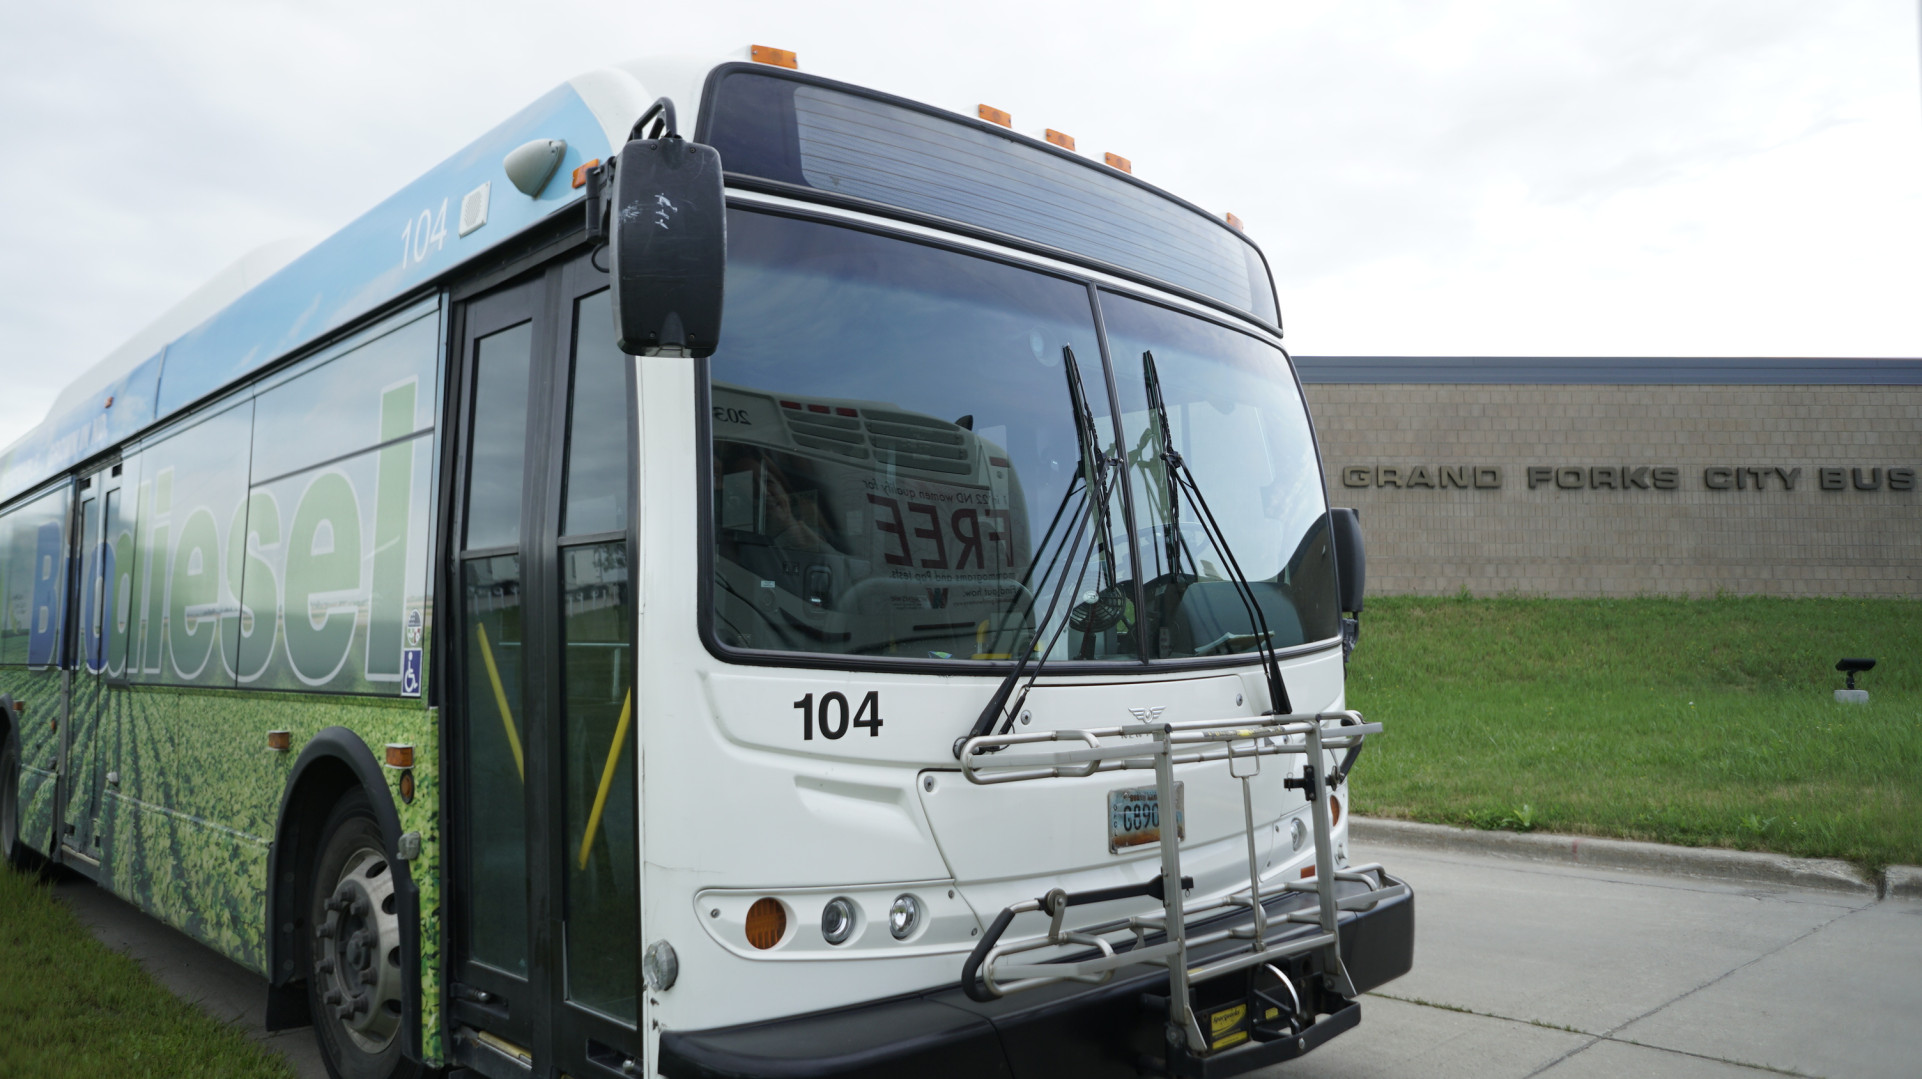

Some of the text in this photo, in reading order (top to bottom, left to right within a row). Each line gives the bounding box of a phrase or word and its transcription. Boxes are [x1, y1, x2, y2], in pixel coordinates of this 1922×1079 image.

[401, 198, 448, 270] 104
[1342, 465, 1916, 491] GRAND FORKS CITY BUS
[28, 374, 419, 686] Biodiesel
[793, 690, 883, 740] 104
